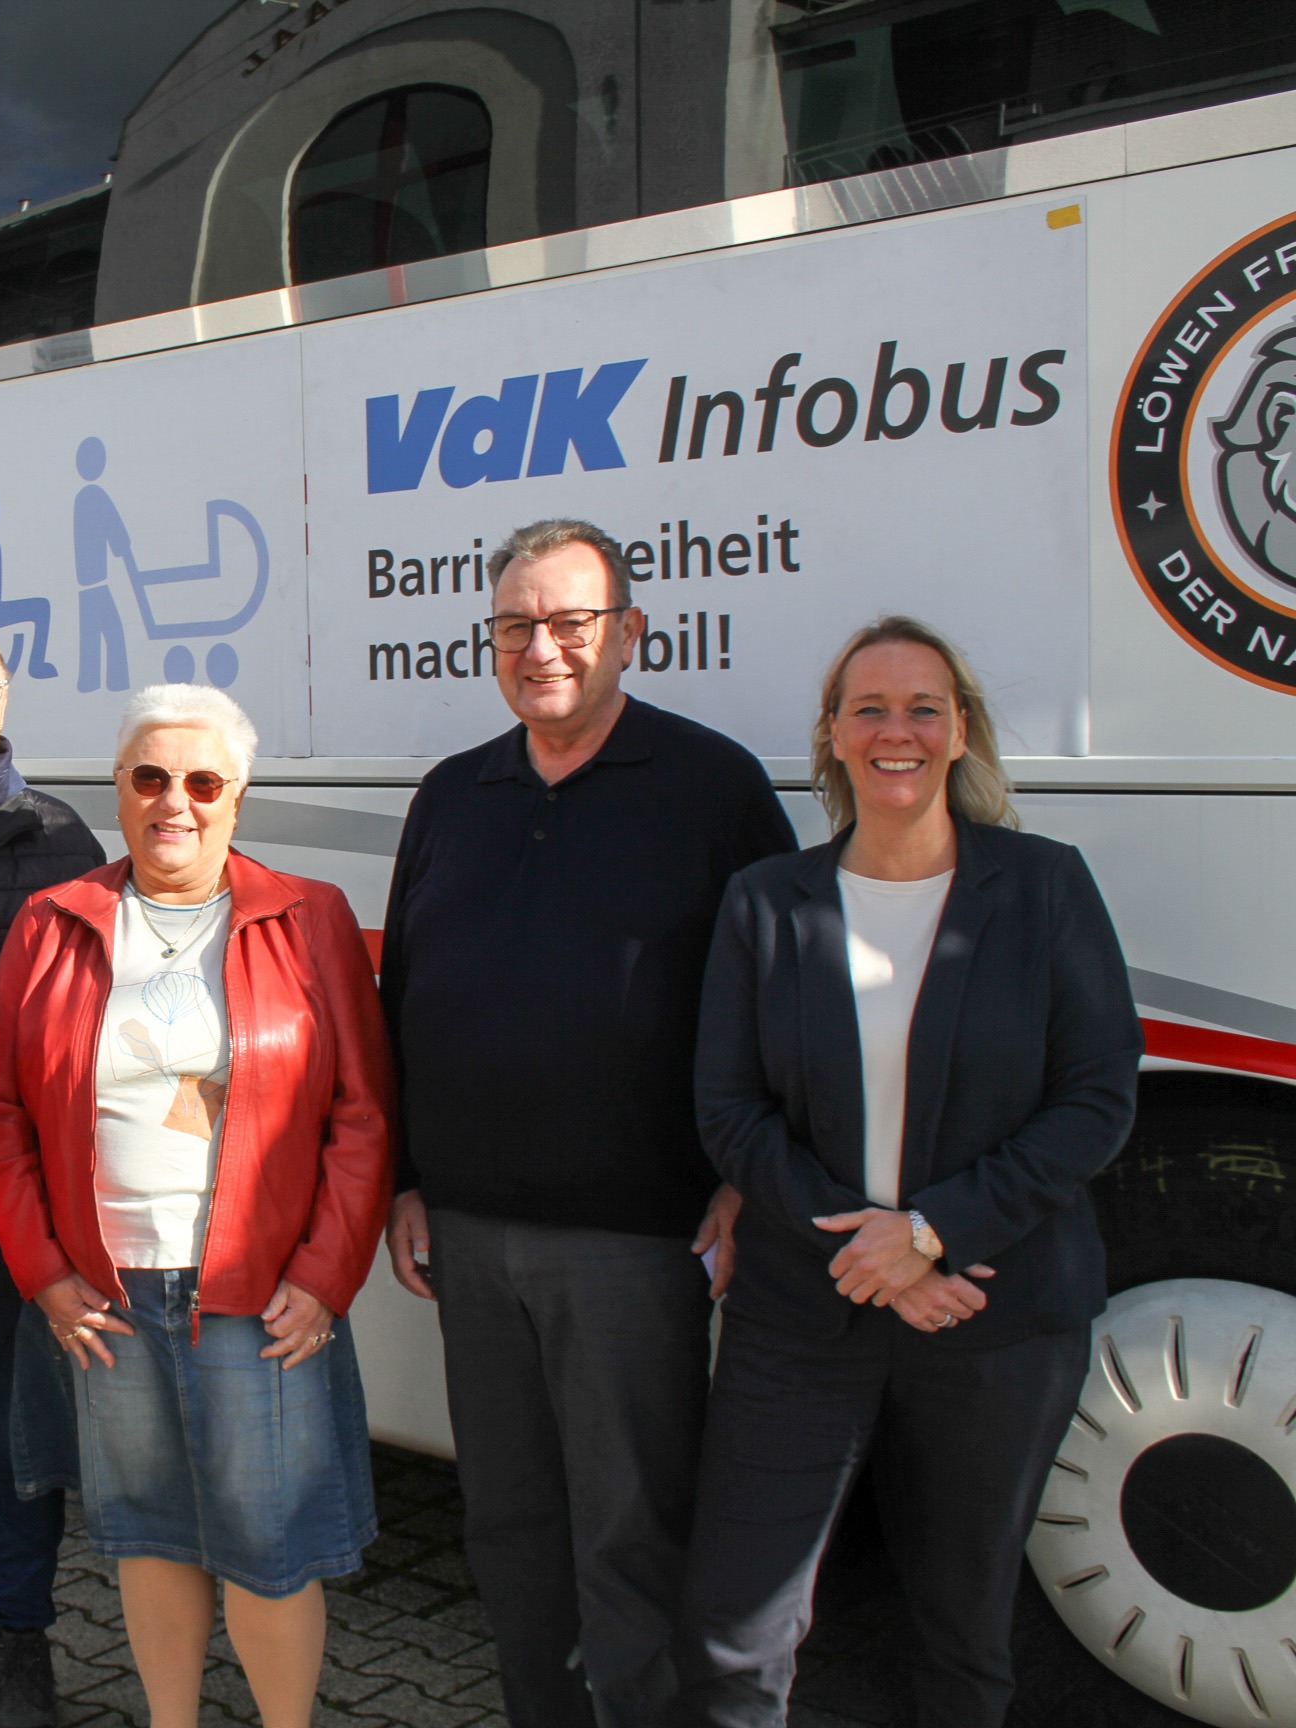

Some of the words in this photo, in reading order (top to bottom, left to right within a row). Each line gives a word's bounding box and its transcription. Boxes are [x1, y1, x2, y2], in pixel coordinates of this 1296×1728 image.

[1135, 290, 1236, 453] LÖWEN
[365, 358, 649, 494] VdK
[658, 340, 1067, 463] Infobus
[368, 514, 800, 598] Barrieiheit
[1158, 549, 1238, 635] DER
[369, 622, 498, 681] mach
[621, 611, 731, 673] bil!
